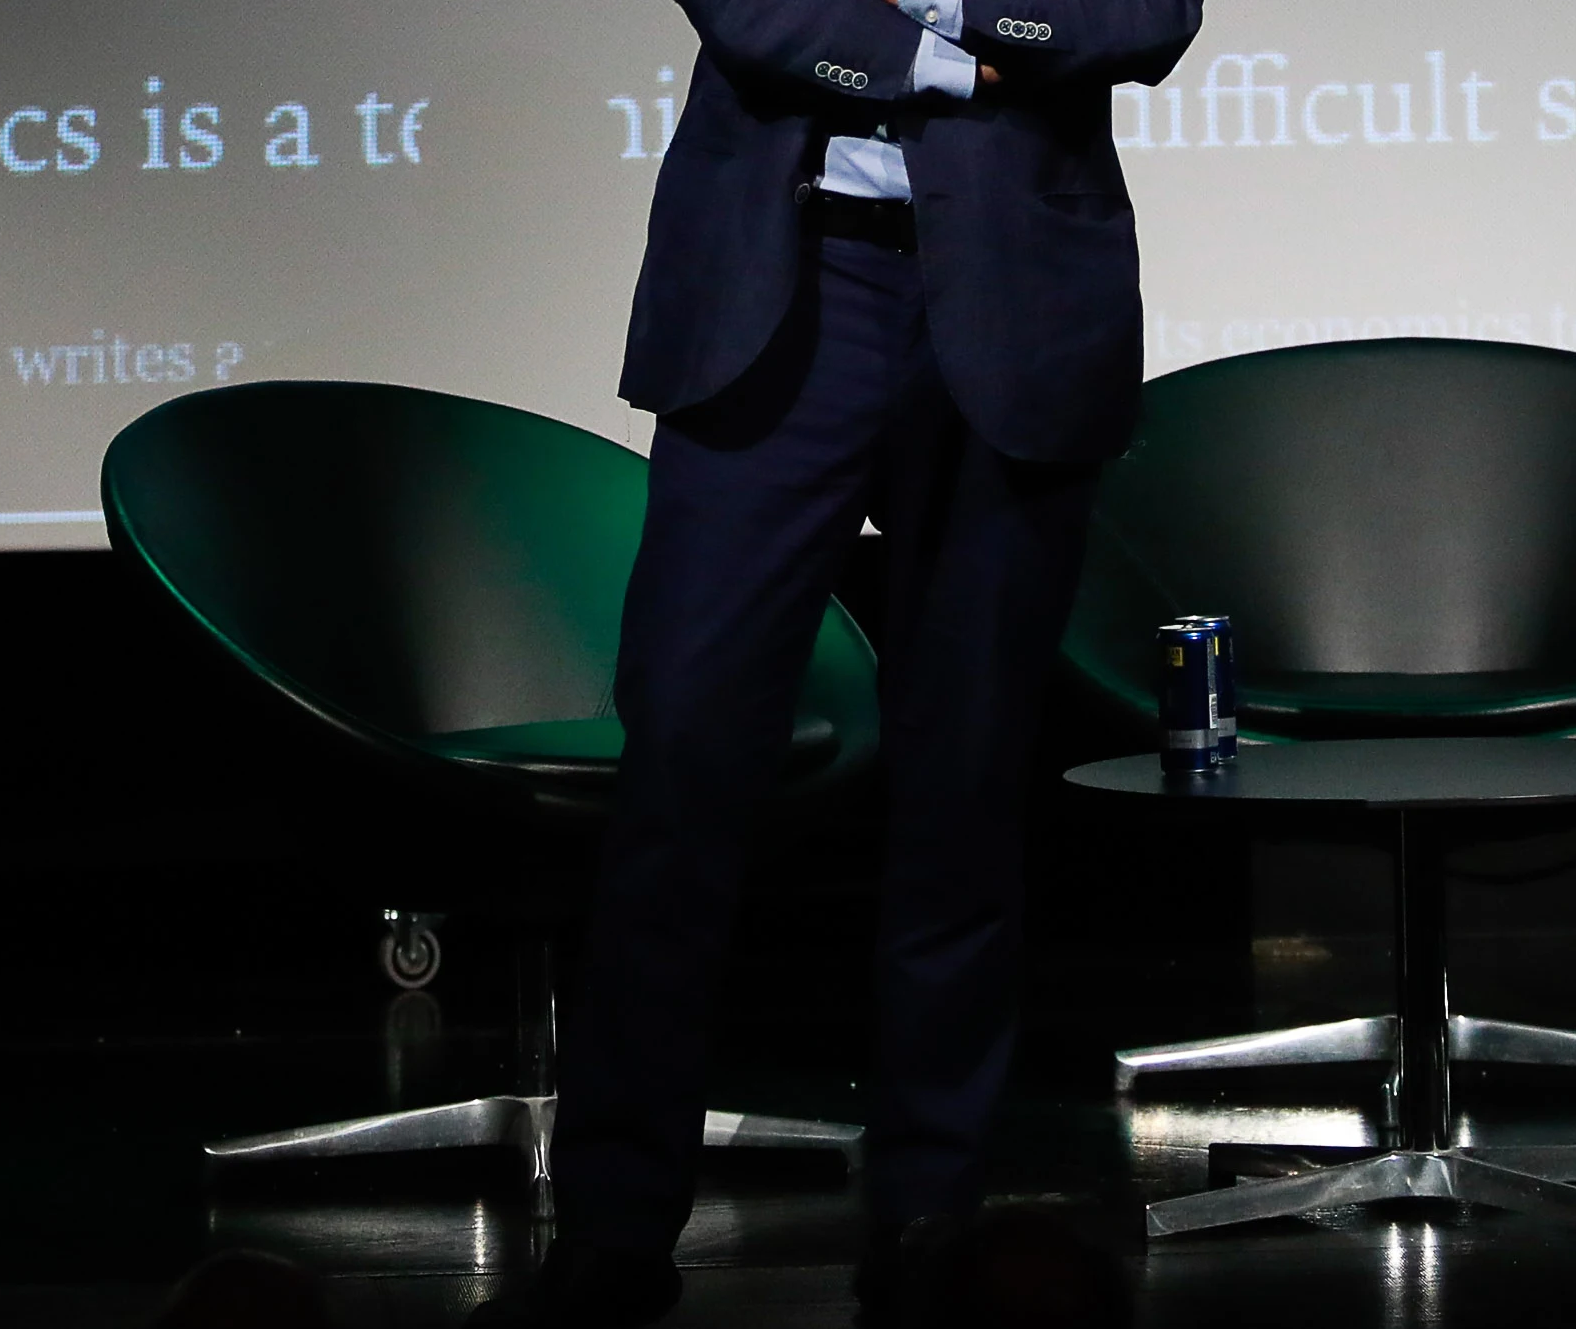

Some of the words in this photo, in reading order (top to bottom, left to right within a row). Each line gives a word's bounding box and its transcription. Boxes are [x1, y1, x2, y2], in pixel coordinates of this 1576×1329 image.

[141, 75, 225, 171] is
[263, 99, 320, 169] a
[9, 328, 195, 387] writes
